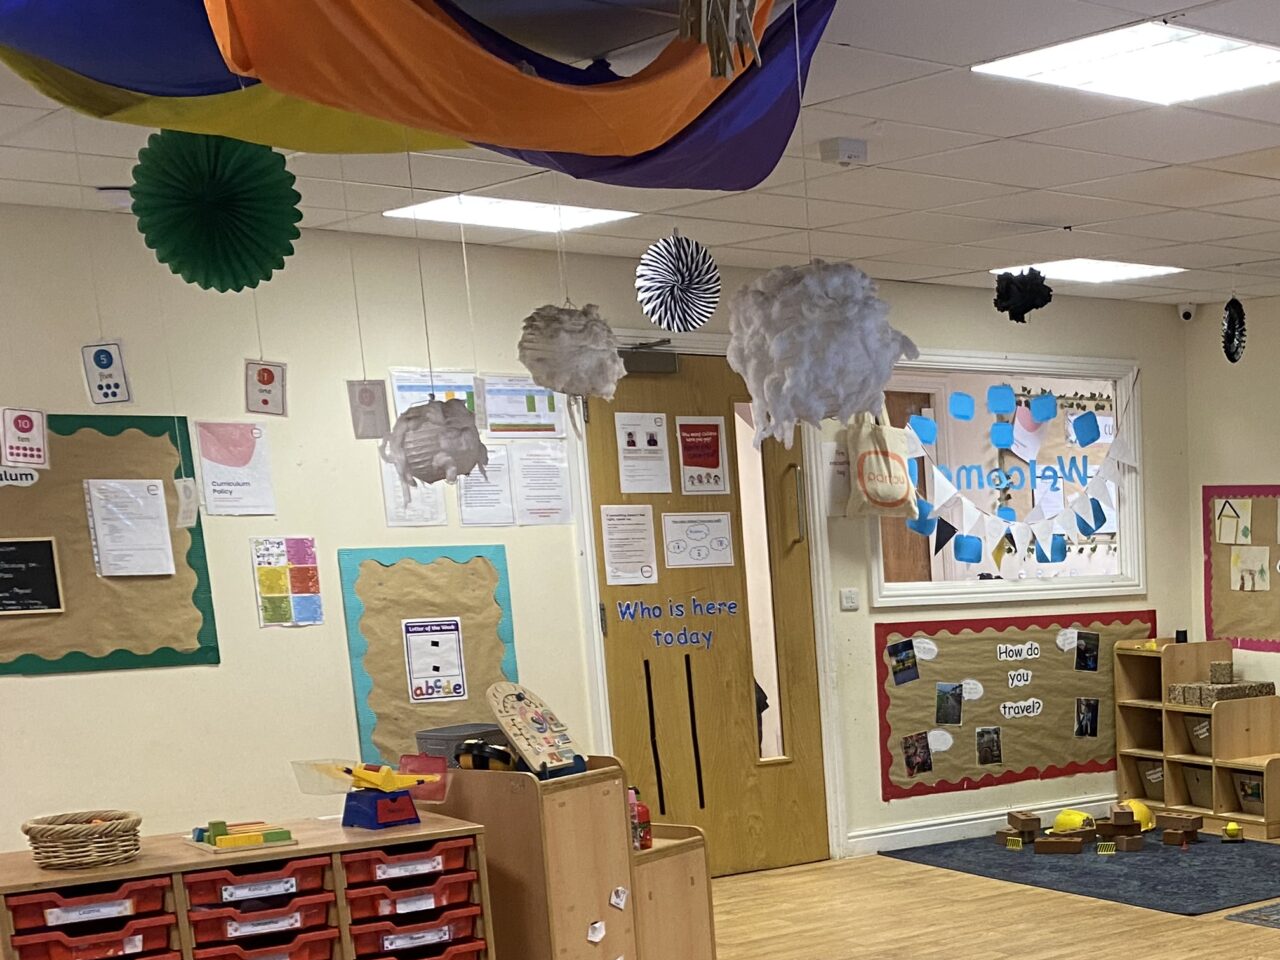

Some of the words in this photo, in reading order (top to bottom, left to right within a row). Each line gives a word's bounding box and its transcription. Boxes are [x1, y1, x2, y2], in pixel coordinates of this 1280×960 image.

[100, 354, 108, 365] 5
[18, 419, 30, 429] 10
[212, 488, 233, 496] Policy
[617, 600, 662, 620] Who
[669, 599, 685, 617] is
[692, 597, 738, 616] here
[653, 626, 712, 649] today
[998, 646, 1023, 659] How
[1026, 643, 1040, 658] do
[1009, 671, 1029, 687] you
[1001, 701, 1042, 716] travel?
